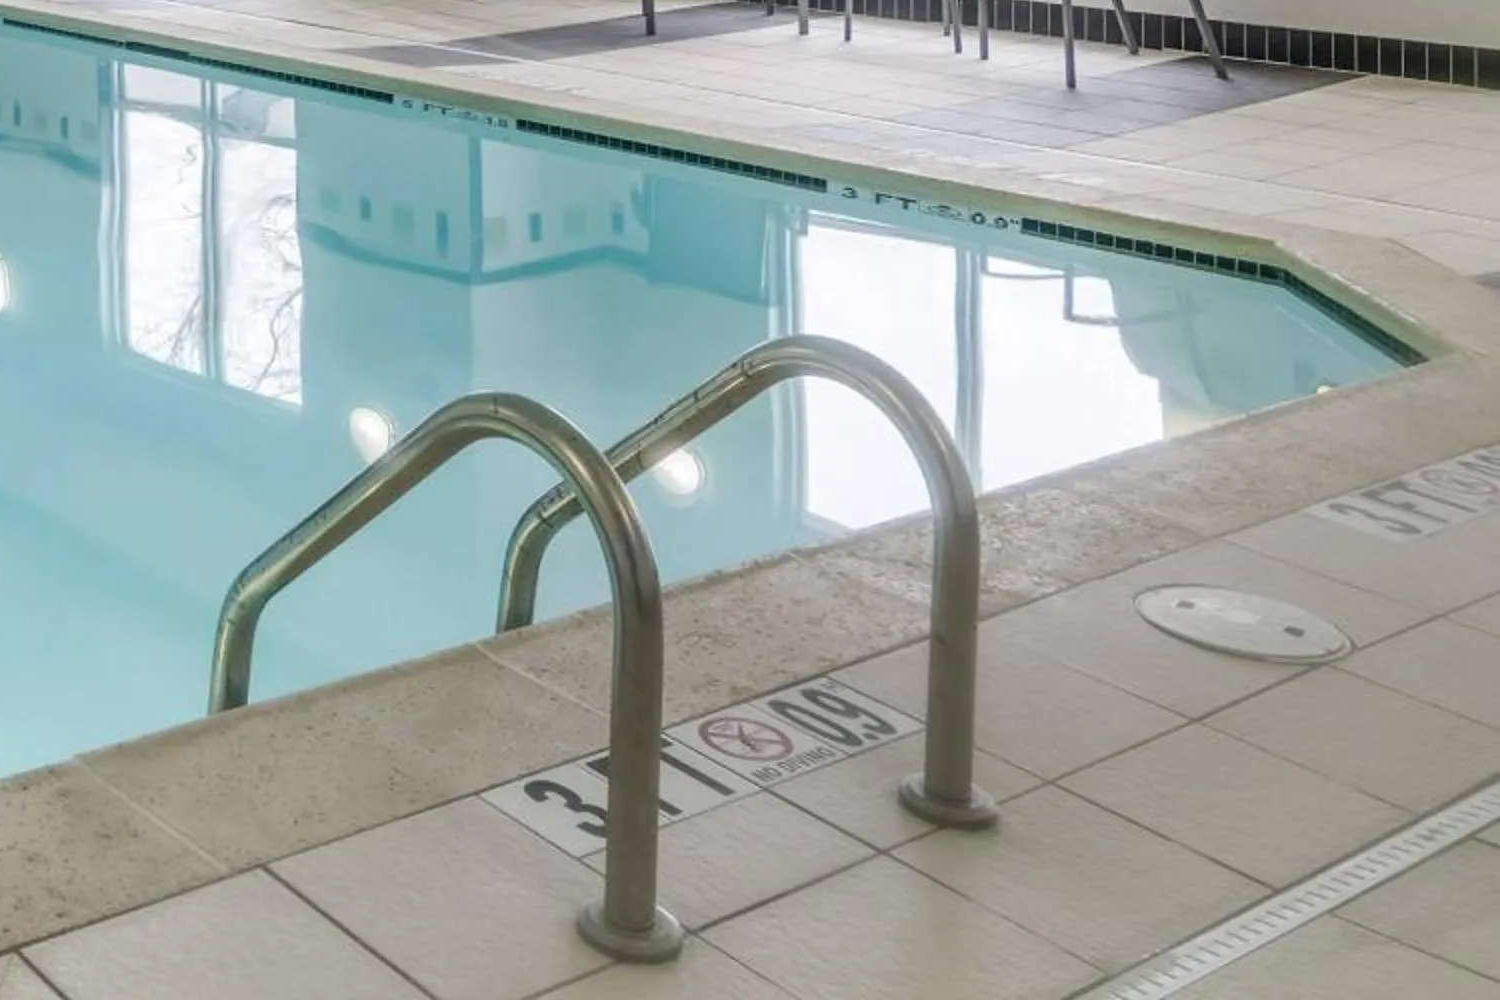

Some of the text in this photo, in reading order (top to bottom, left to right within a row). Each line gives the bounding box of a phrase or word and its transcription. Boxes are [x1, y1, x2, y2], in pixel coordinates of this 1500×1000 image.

[841, 187, 859, 200] 3
[875, 193, 917, 209] FT
[1328, 480, 1480, 536] 3 FT
[752, 746, 837, 783] NO DIVING
[523, 779, 607, 839] 3
